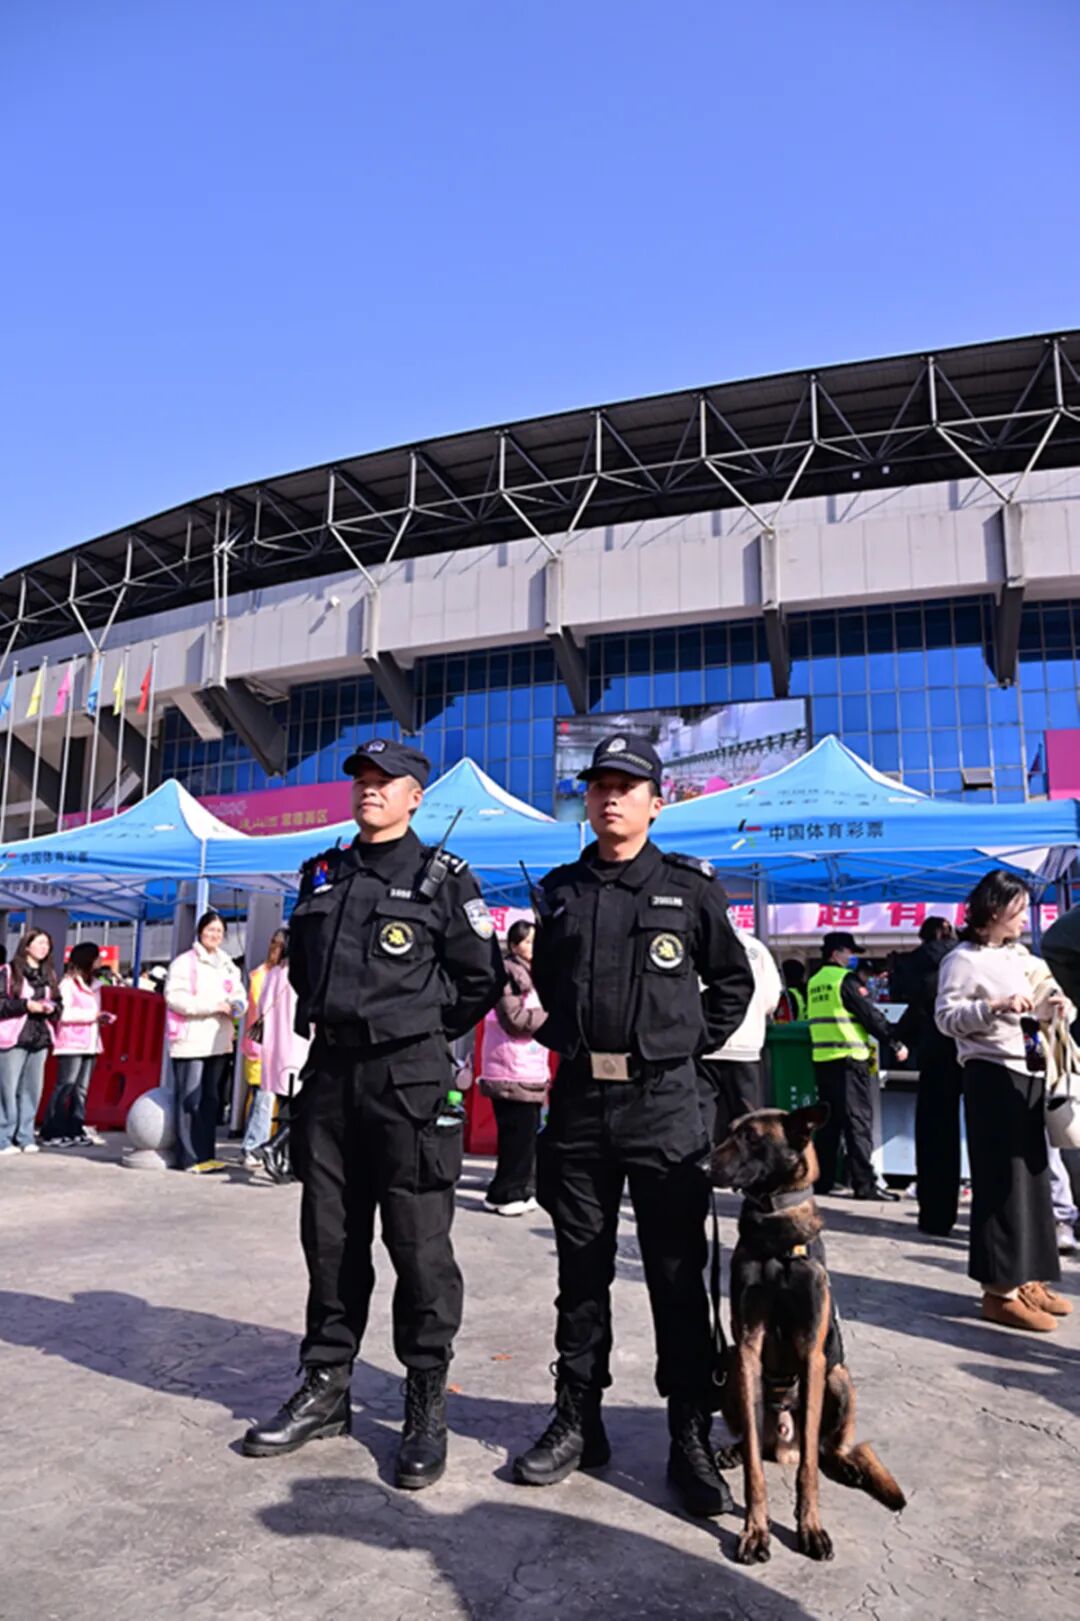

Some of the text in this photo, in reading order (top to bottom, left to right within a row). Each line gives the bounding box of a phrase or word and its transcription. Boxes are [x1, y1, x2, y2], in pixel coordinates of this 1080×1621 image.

[769, 821, 884, 841] 中国体育彩票
